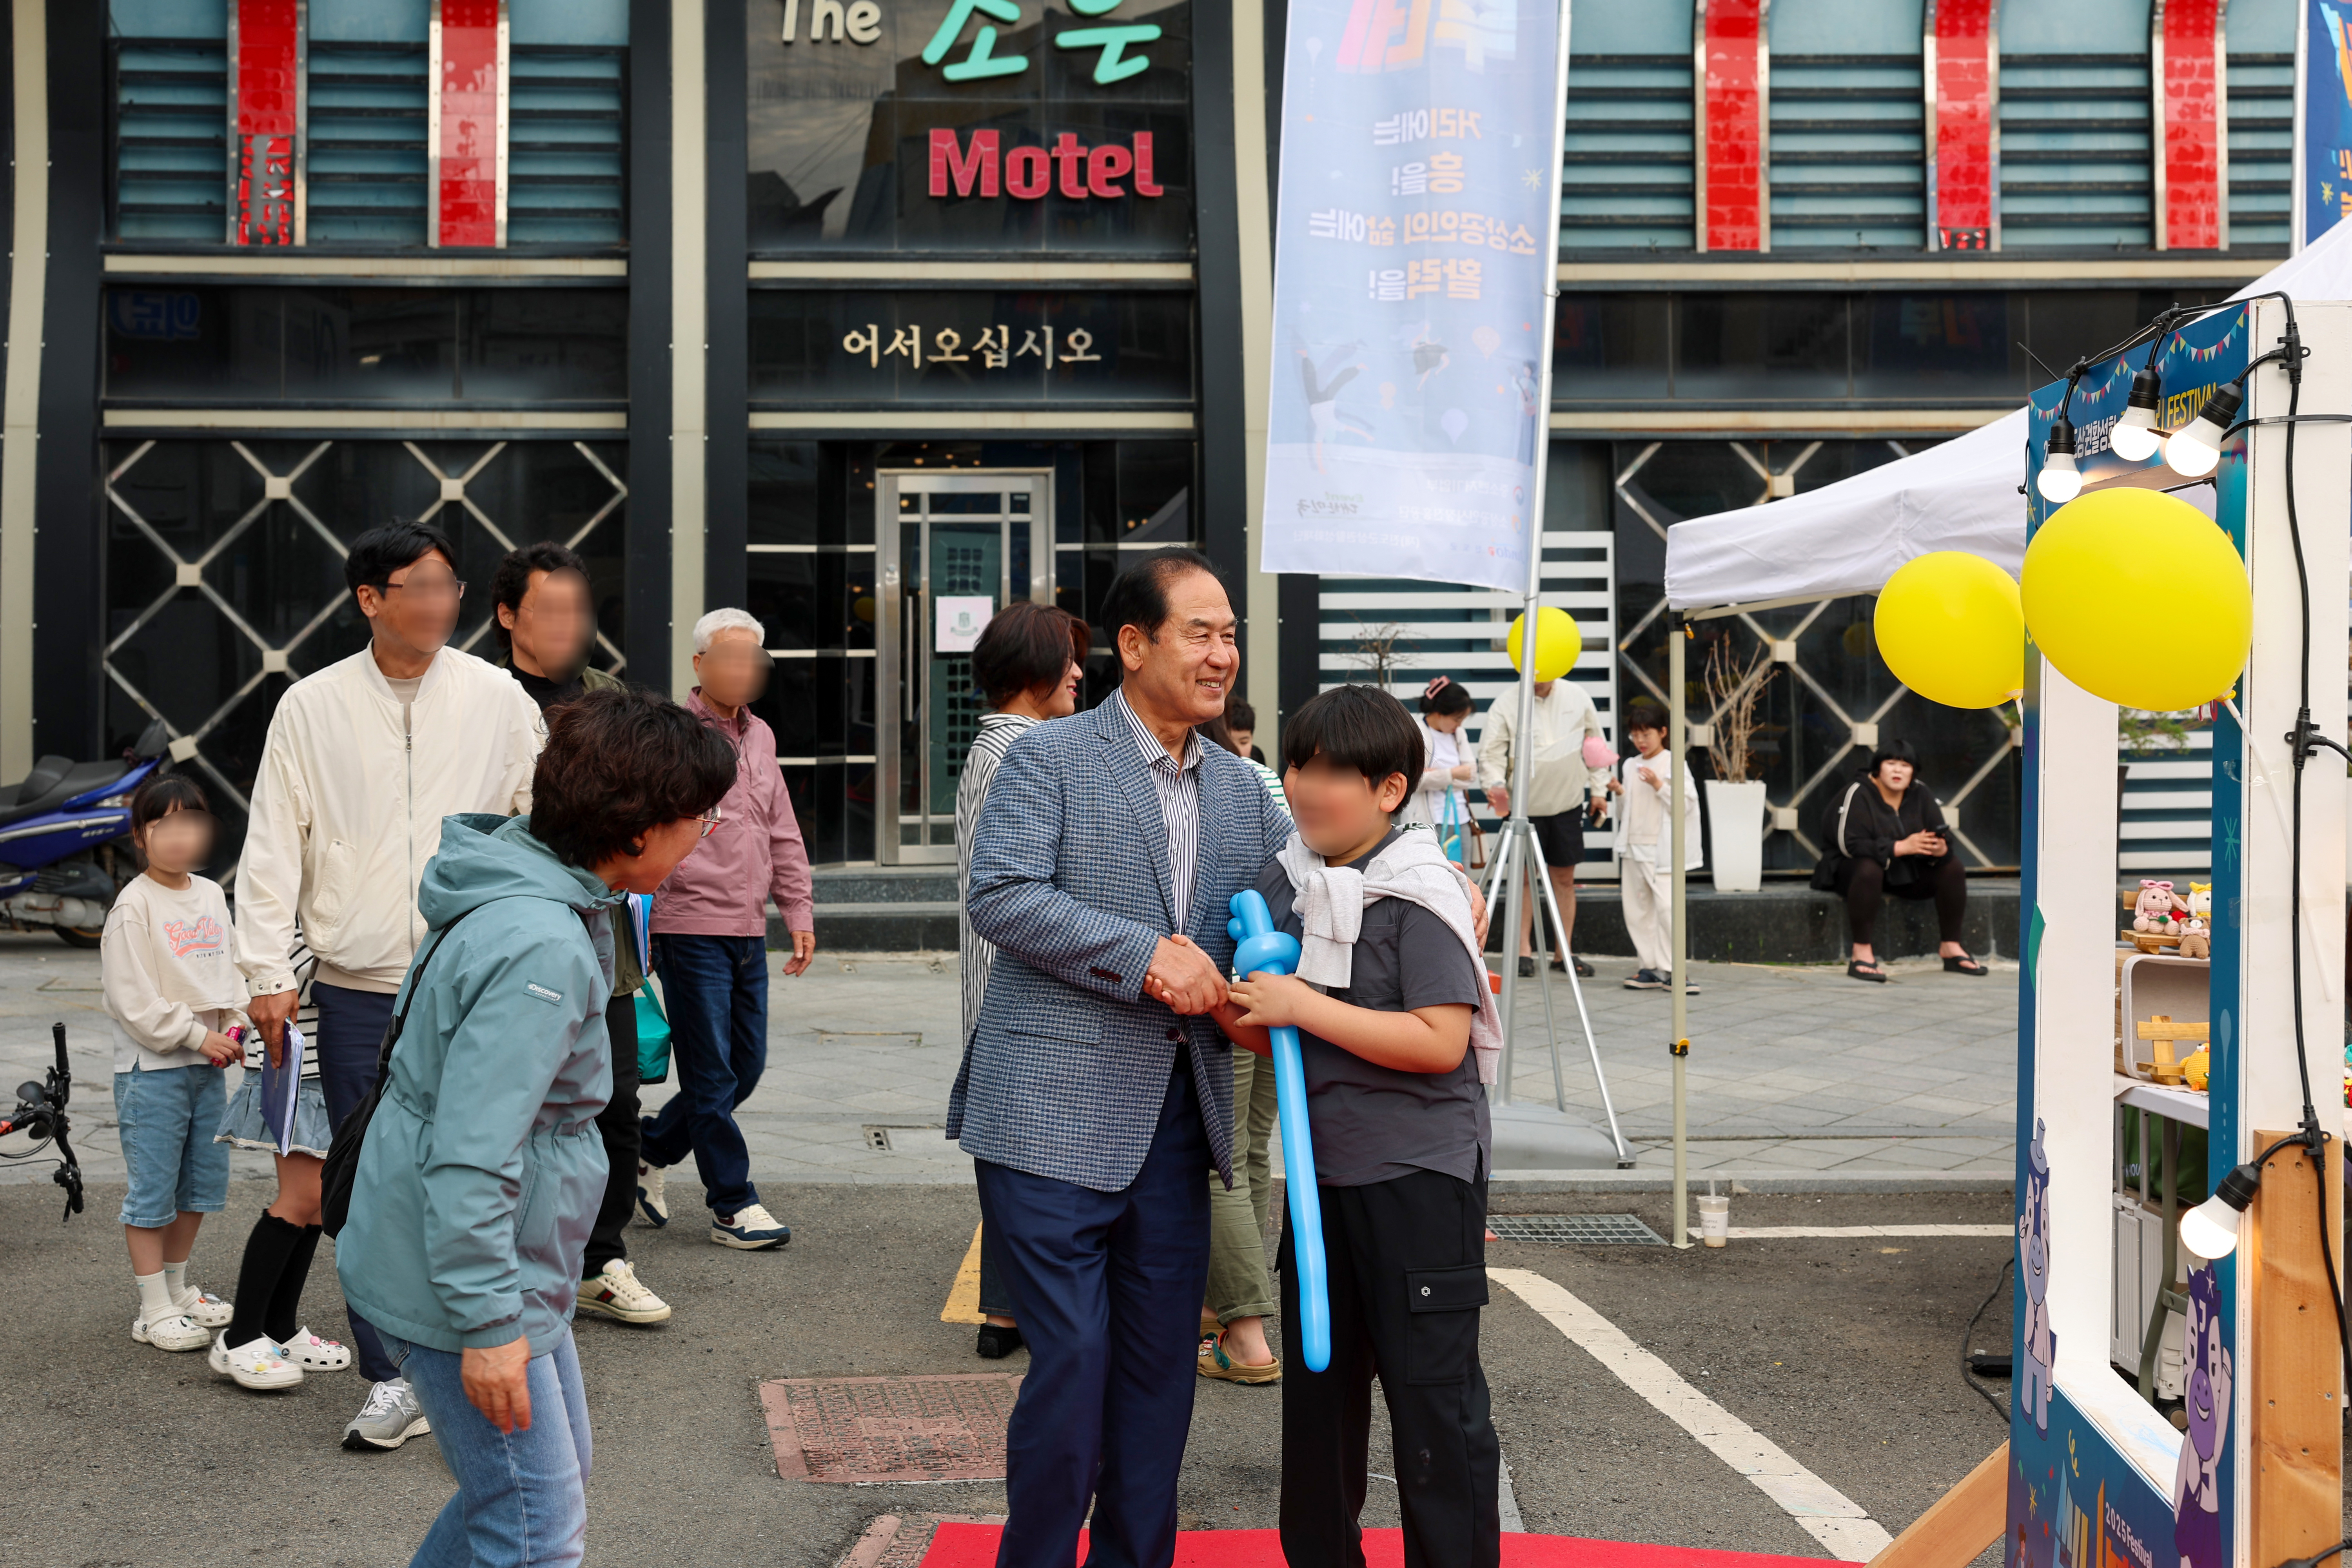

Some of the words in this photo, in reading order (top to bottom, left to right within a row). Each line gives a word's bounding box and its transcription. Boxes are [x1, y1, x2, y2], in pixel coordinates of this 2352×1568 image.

[780, 0, 882, 45] The
[929, 128, 1163, 199] Motel
[843, 324, 1101, 370] 어서오십시오
[163, 920, 199, 951] Good
